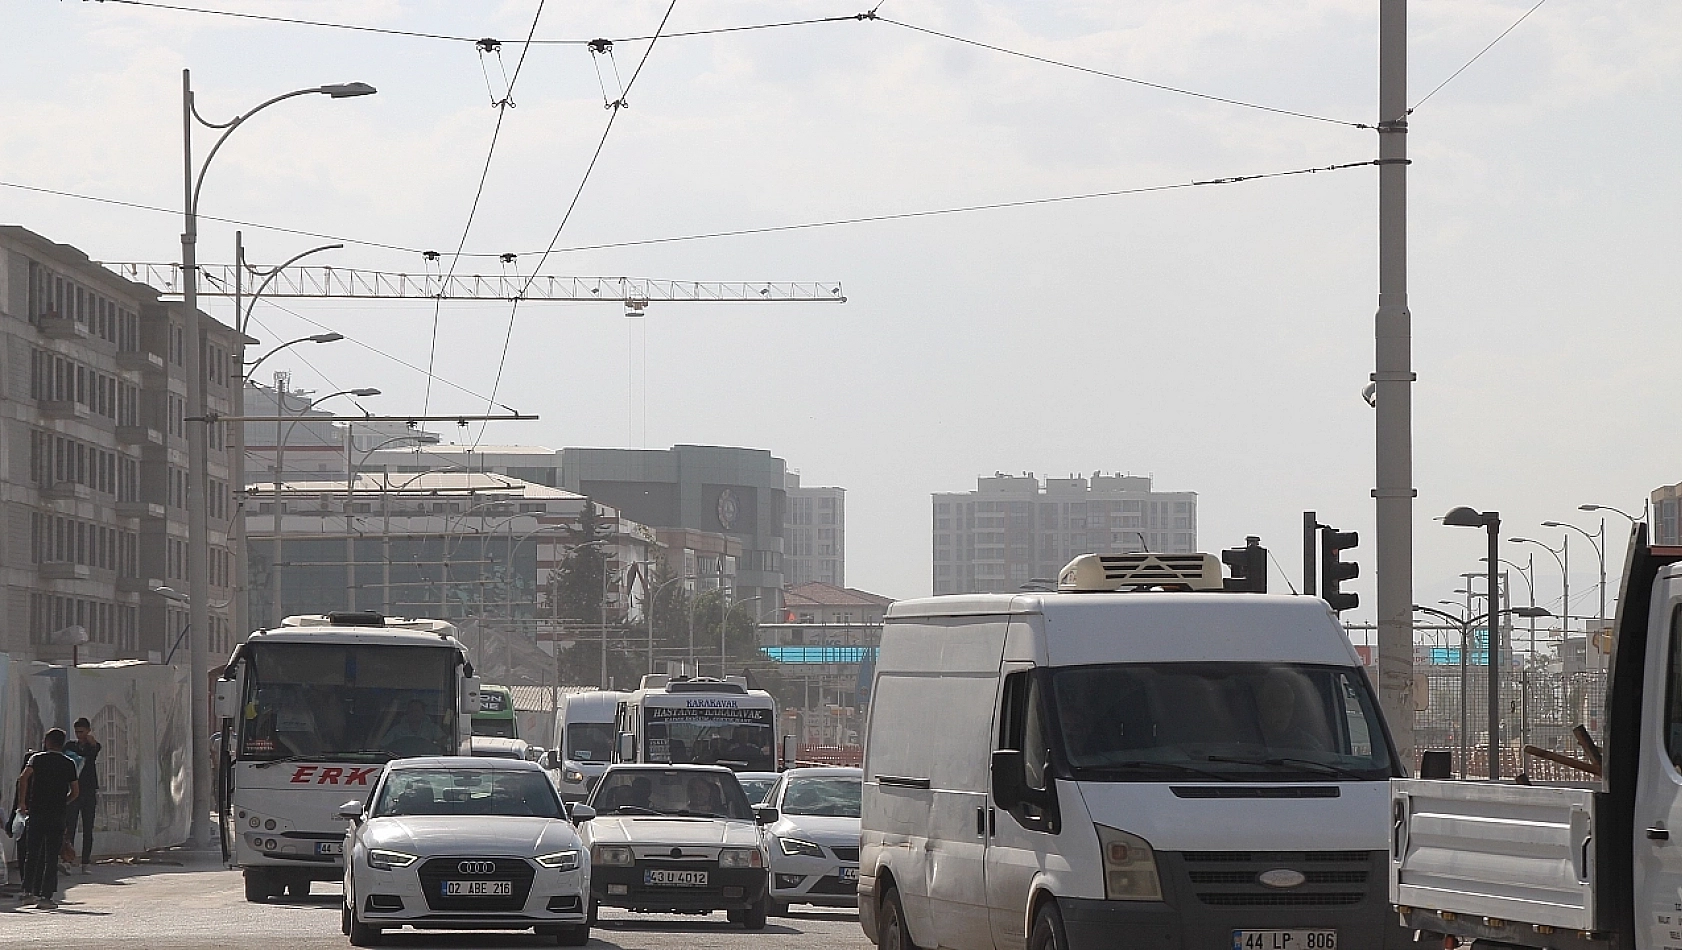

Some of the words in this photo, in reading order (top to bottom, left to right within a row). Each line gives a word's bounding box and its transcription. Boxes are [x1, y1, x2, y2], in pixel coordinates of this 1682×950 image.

[321, 843, 331, 853] 44
[651, 871, 665, 882] 43
[667, 872, 674, 882] U
[677, 872, 706, 884] 4012
[448, 882, 461, 894] 02
[468, 882, 488, 894] ABE
[493, 883, 510, 894] 216
[1245, 932, 1263, 949] 44
[1273, 932, 1291, 949] LP
[1307, 932, 1335, 949] 806
